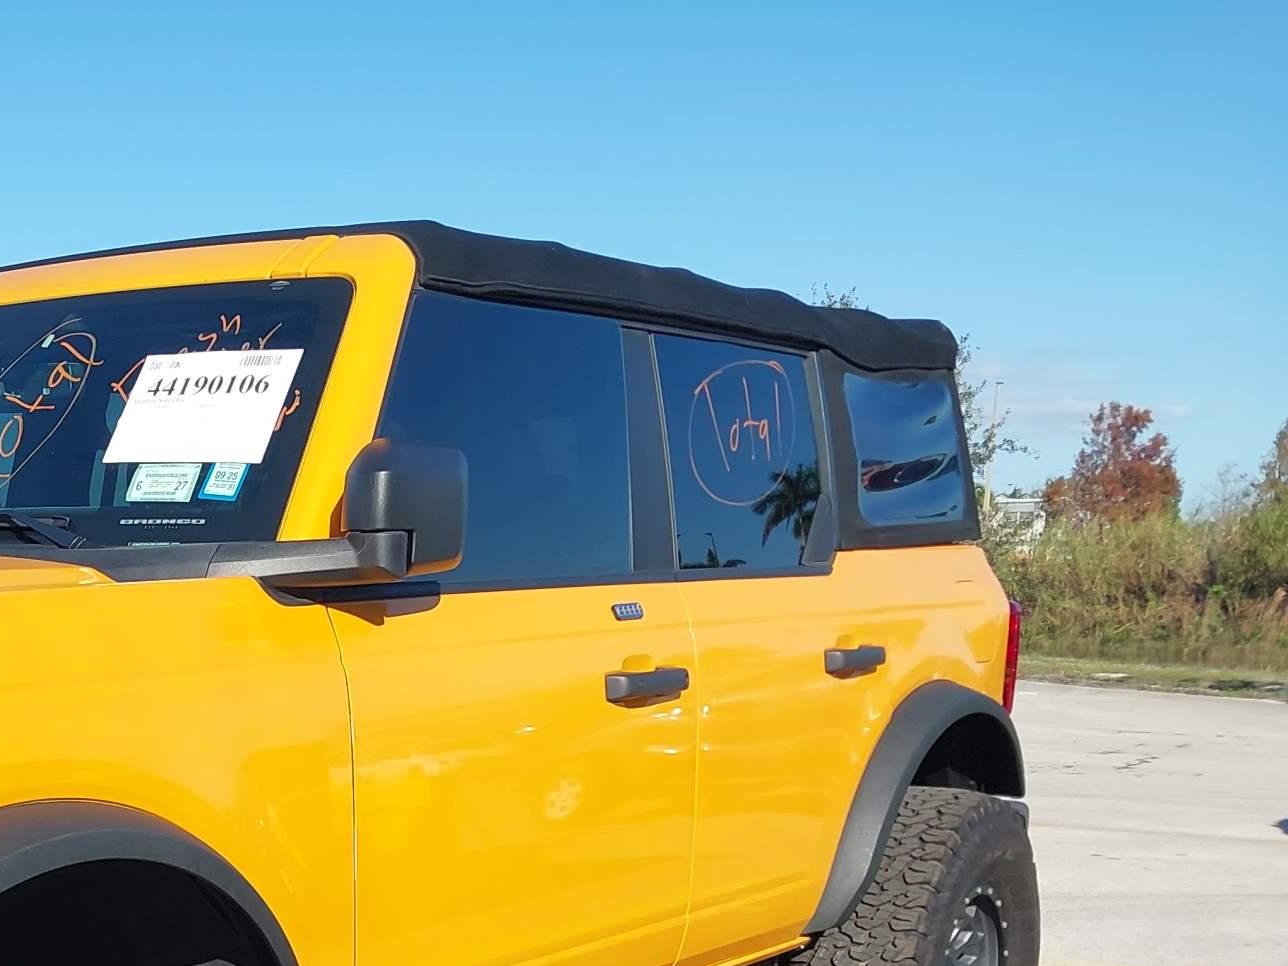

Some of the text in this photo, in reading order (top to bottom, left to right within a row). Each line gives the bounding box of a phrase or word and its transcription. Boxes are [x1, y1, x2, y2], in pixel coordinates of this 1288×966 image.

[147, 374, 272, 396] 44190106
[135, 480, 143, 491] 6
[174, 480, 188, 491] 27
